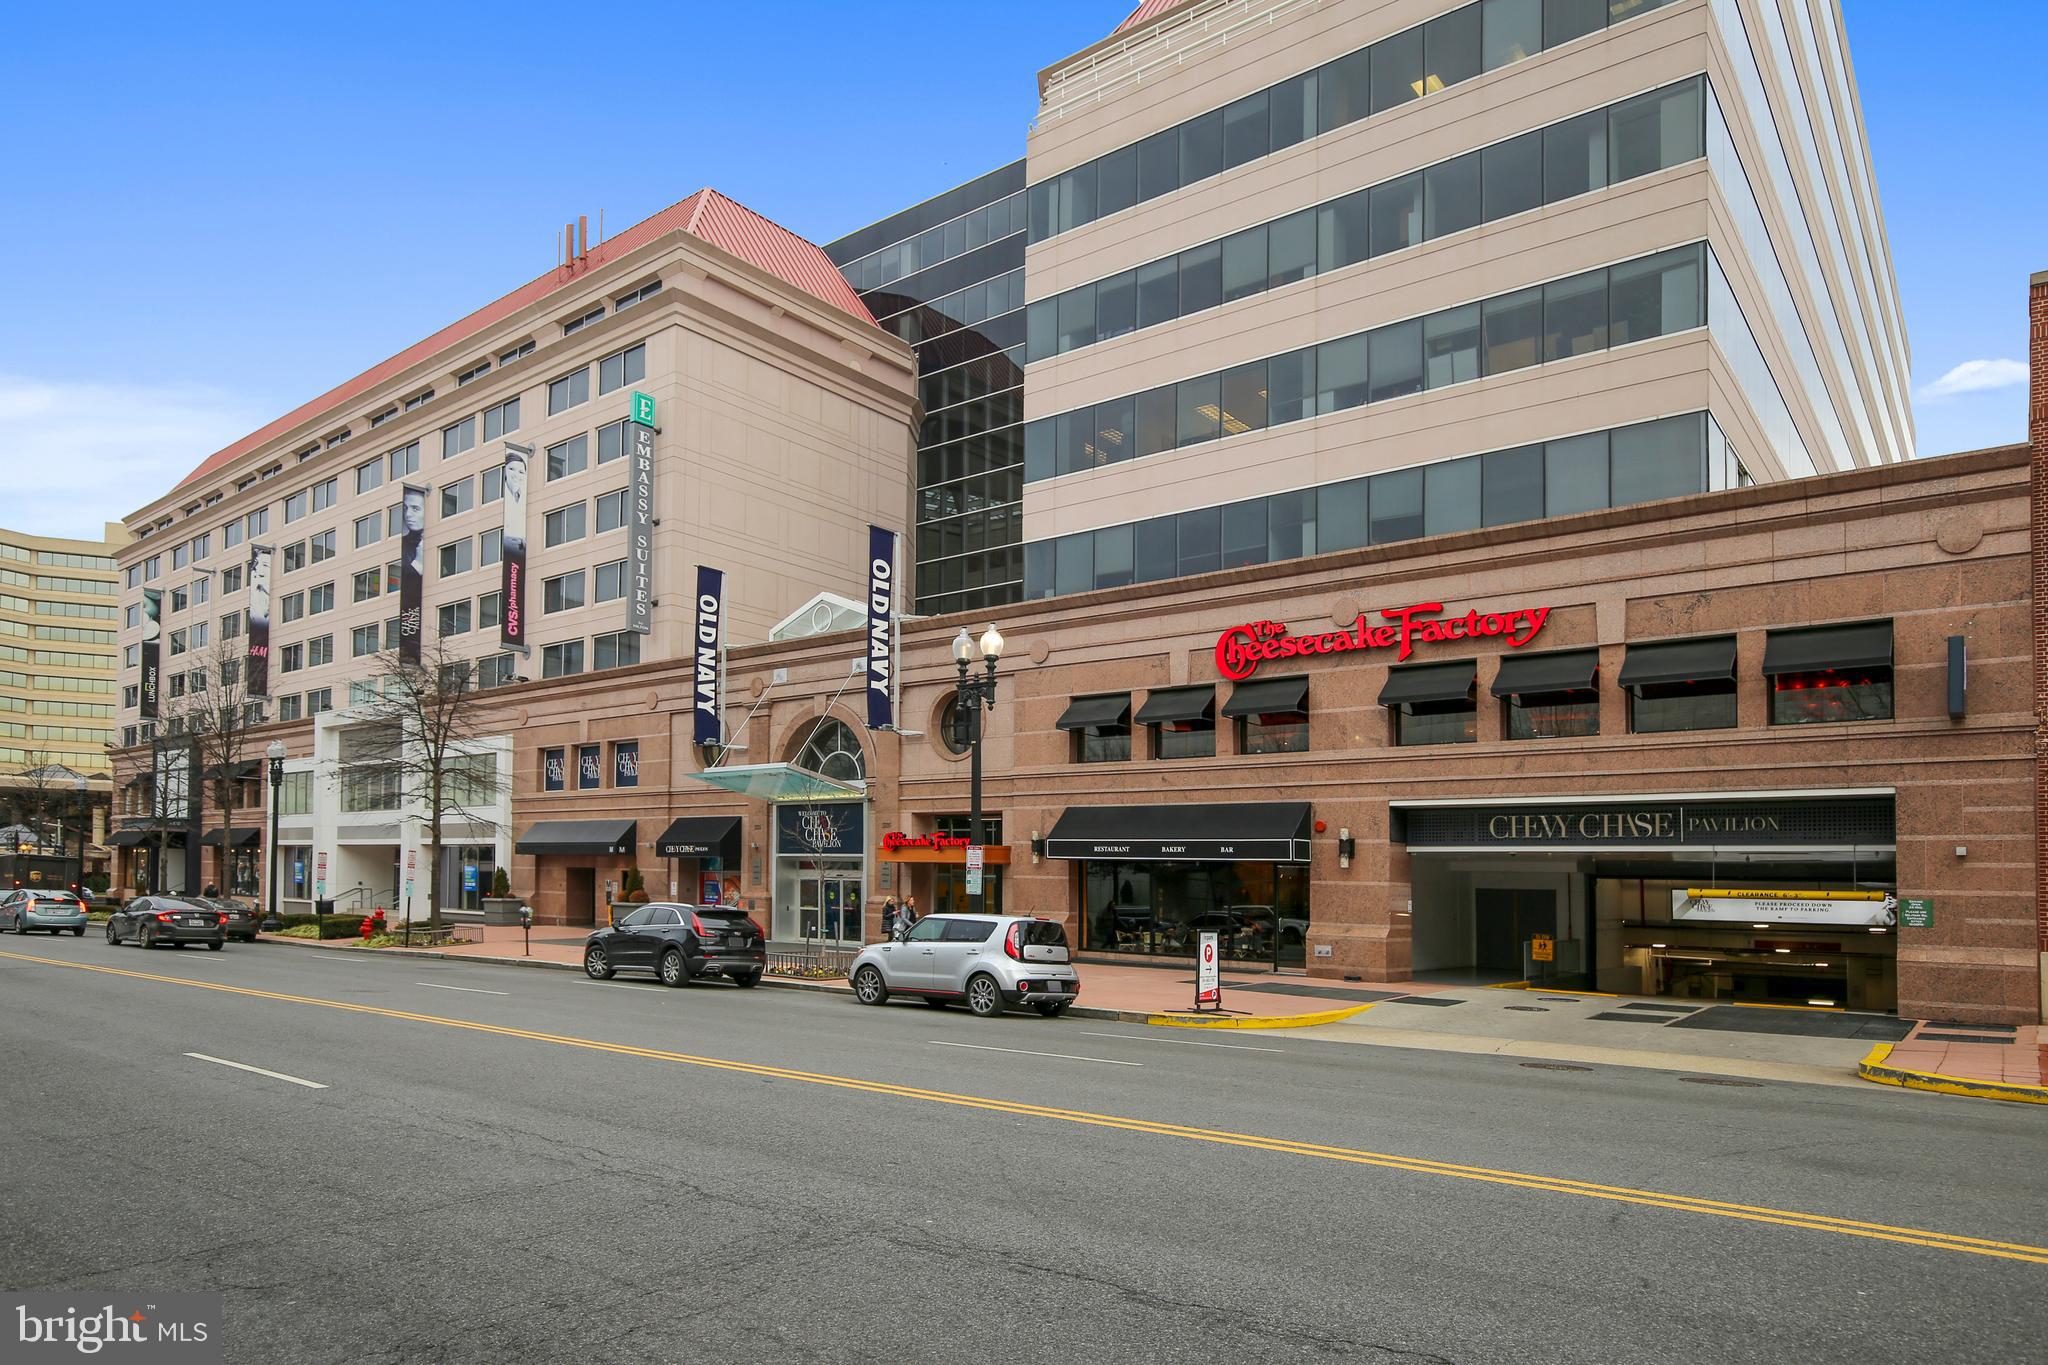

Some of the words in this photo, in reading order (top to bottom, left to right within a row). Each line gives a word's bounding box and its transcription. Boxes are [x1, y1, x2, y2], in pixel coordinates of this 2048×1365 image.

[639, 398, 651, 420] E
[636, 430, 651, 525] EMBASSY
[508, 562, 519, 636] CVS/pharmacy
[635, 535, 650, 616] SUITES
[871, 558, 891, 615] OLD
[698, 594, 718, 644] OLD
[1215, 615, 1397, 681] Cheesecake
[1381, 602, 1551, 663] Factory
[1254, 620, 1286, 638] The
[697, 647, 716, 716] NAVY
[870, 618, 889, 697] NAVY
[148, 666, 157, 703] LUNCHBOX
[805, 828, 837, 841] CHASE
[882, 832, 931, 852] Cheesecake
[930, 831, 971, 851] Factory
[1489, 814, 1575, 839] CHEVY
[1578, 812, 1675, 838] CHASE
[1689, 816, 1780, 832] PAVILION
